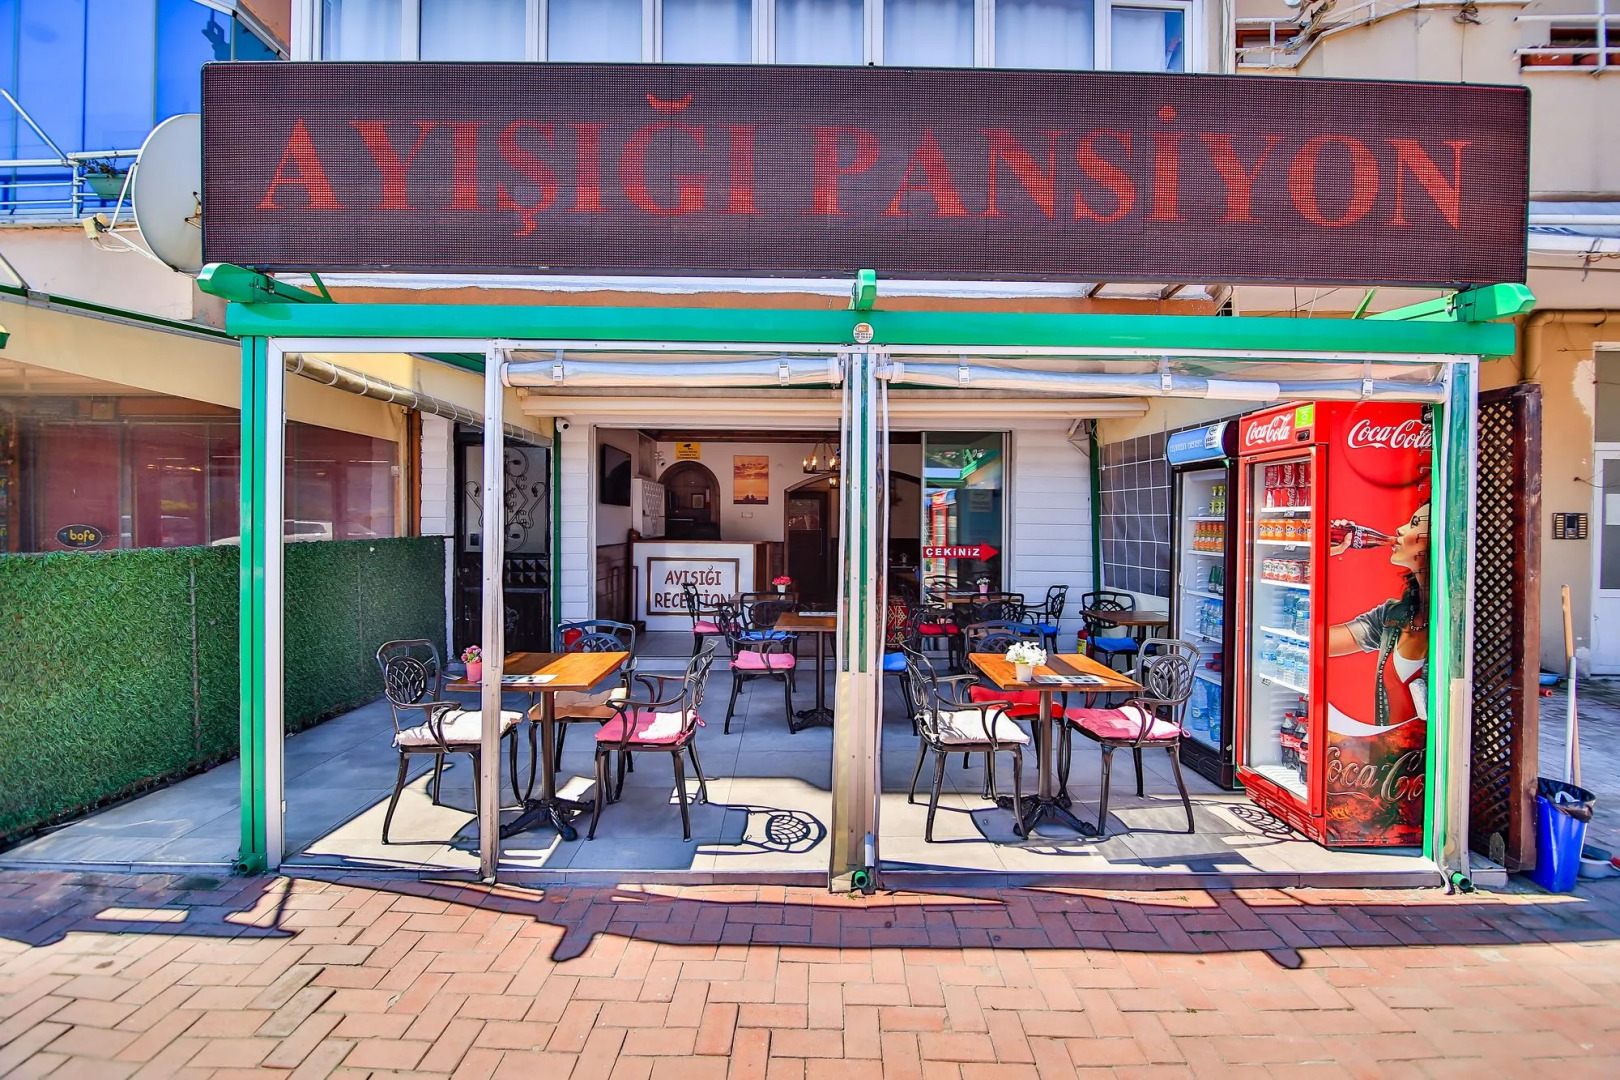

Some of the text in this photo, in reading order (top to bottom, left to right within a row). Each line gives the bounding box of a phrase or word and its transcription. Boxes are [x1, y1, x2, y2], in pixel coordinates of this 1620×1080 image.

[256, 92, 1473, 237] AYIŞIĞI PANSİYON
[1245, 413, 1294, 446] Coca-Cola
[69, 530, 96, 542] bofe
